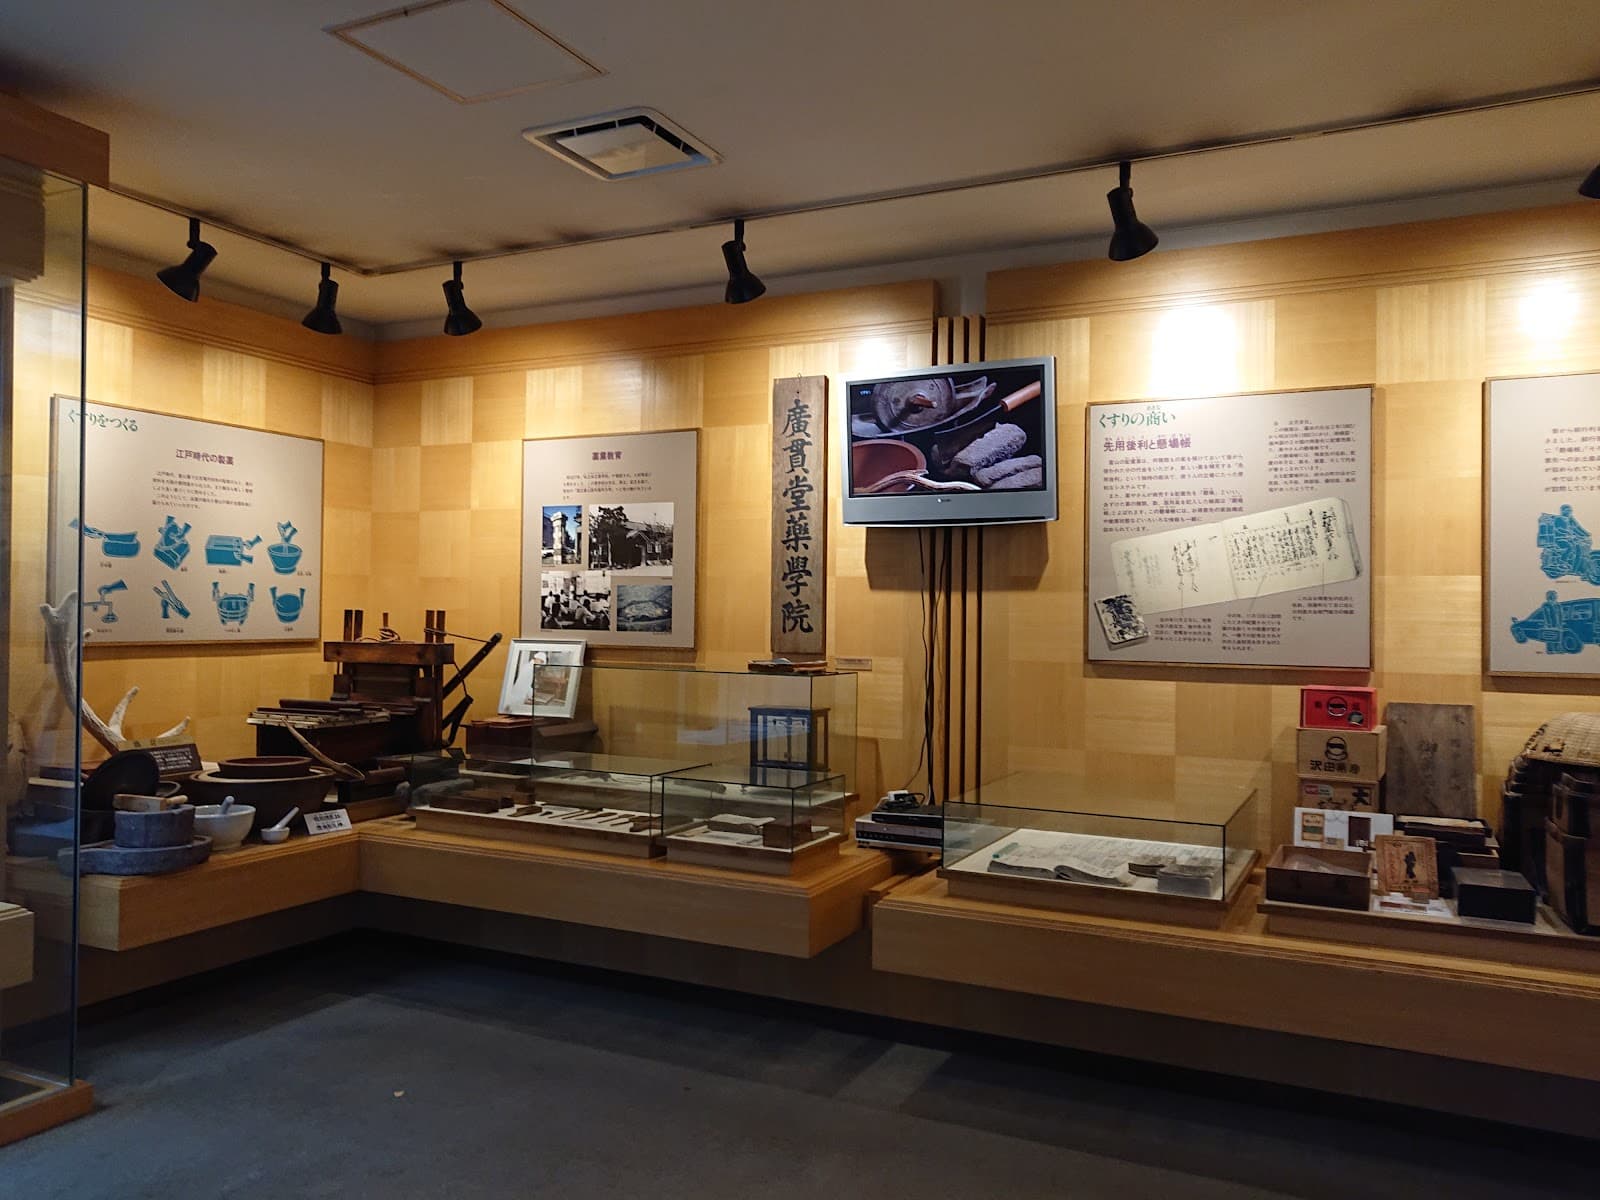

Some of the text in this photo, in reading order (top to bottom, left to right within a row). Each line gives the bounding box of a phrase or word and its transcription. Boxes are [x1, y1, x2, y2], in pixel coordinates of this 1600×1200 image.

[68, 409, 138, 432] くりをつくる
[1099, 411, 1176, 428] くすりの商い
